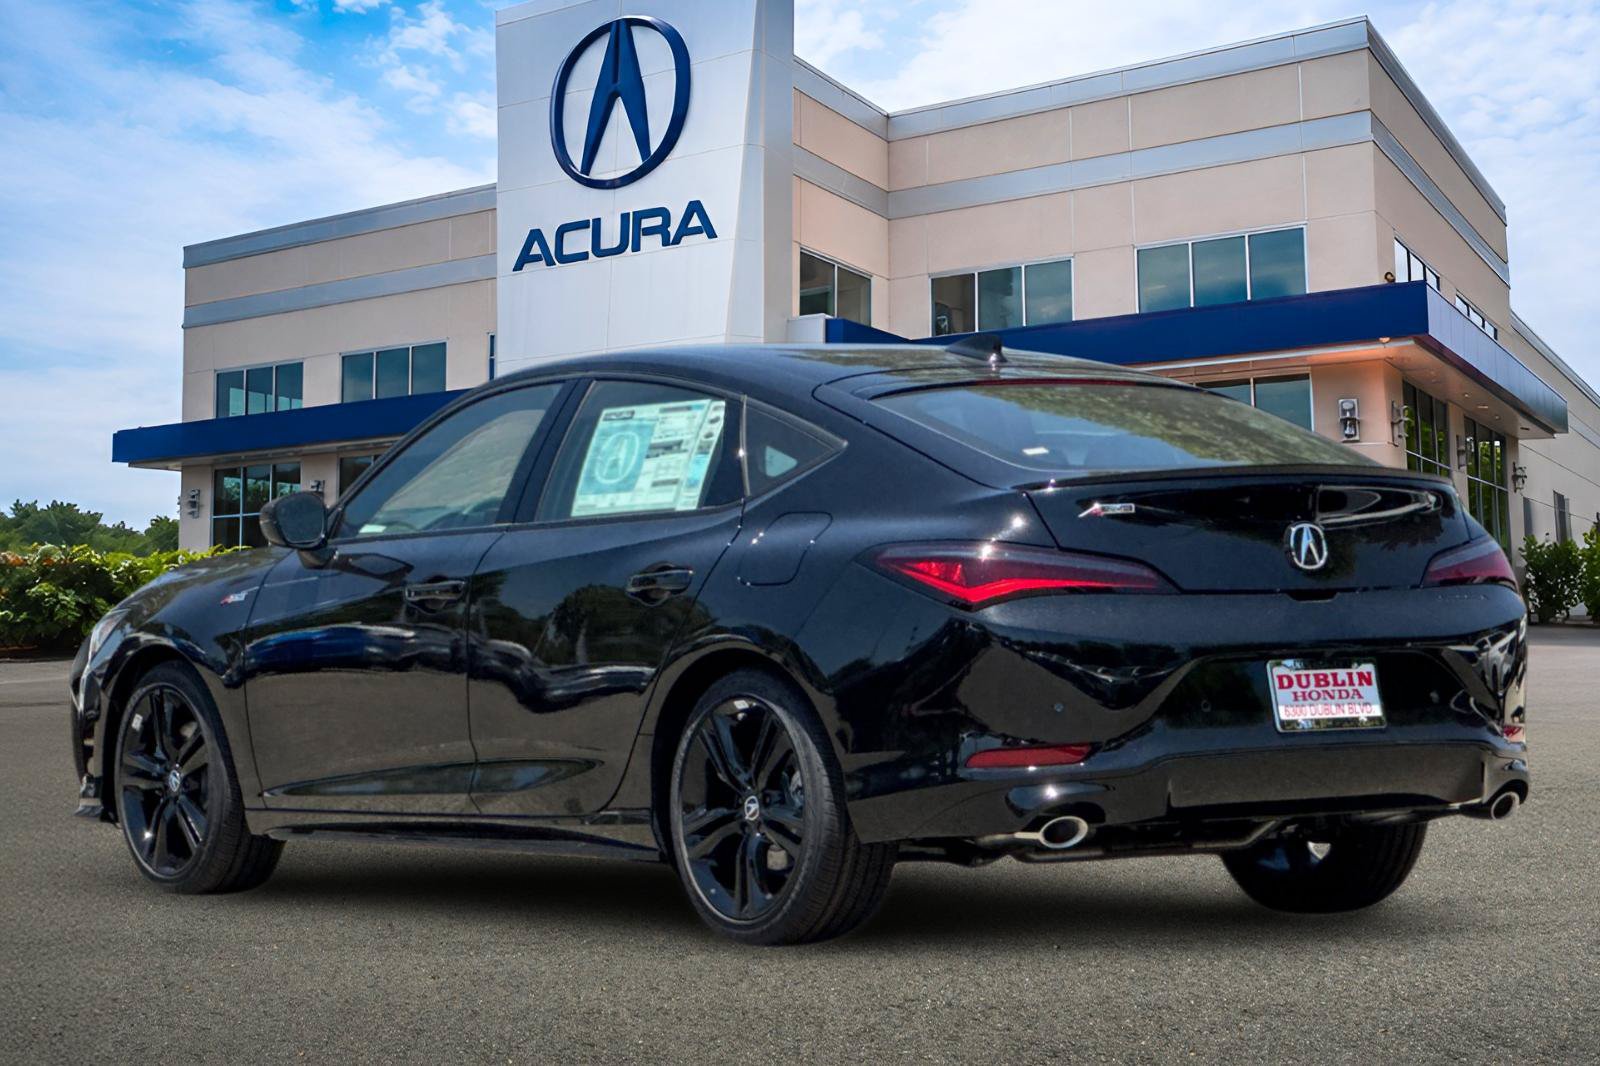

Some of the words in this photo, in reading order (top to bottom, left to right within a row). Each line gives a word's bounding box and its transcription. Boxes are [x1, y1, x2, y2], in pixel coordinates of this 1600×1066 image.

[512, 200, 718, 271] ACURA
[1276, 671, 1373, 690] DUBLIN
[1292, 688, 1364, 701] HONDA
[1310, 703, 1345, 716] DUBLIN
